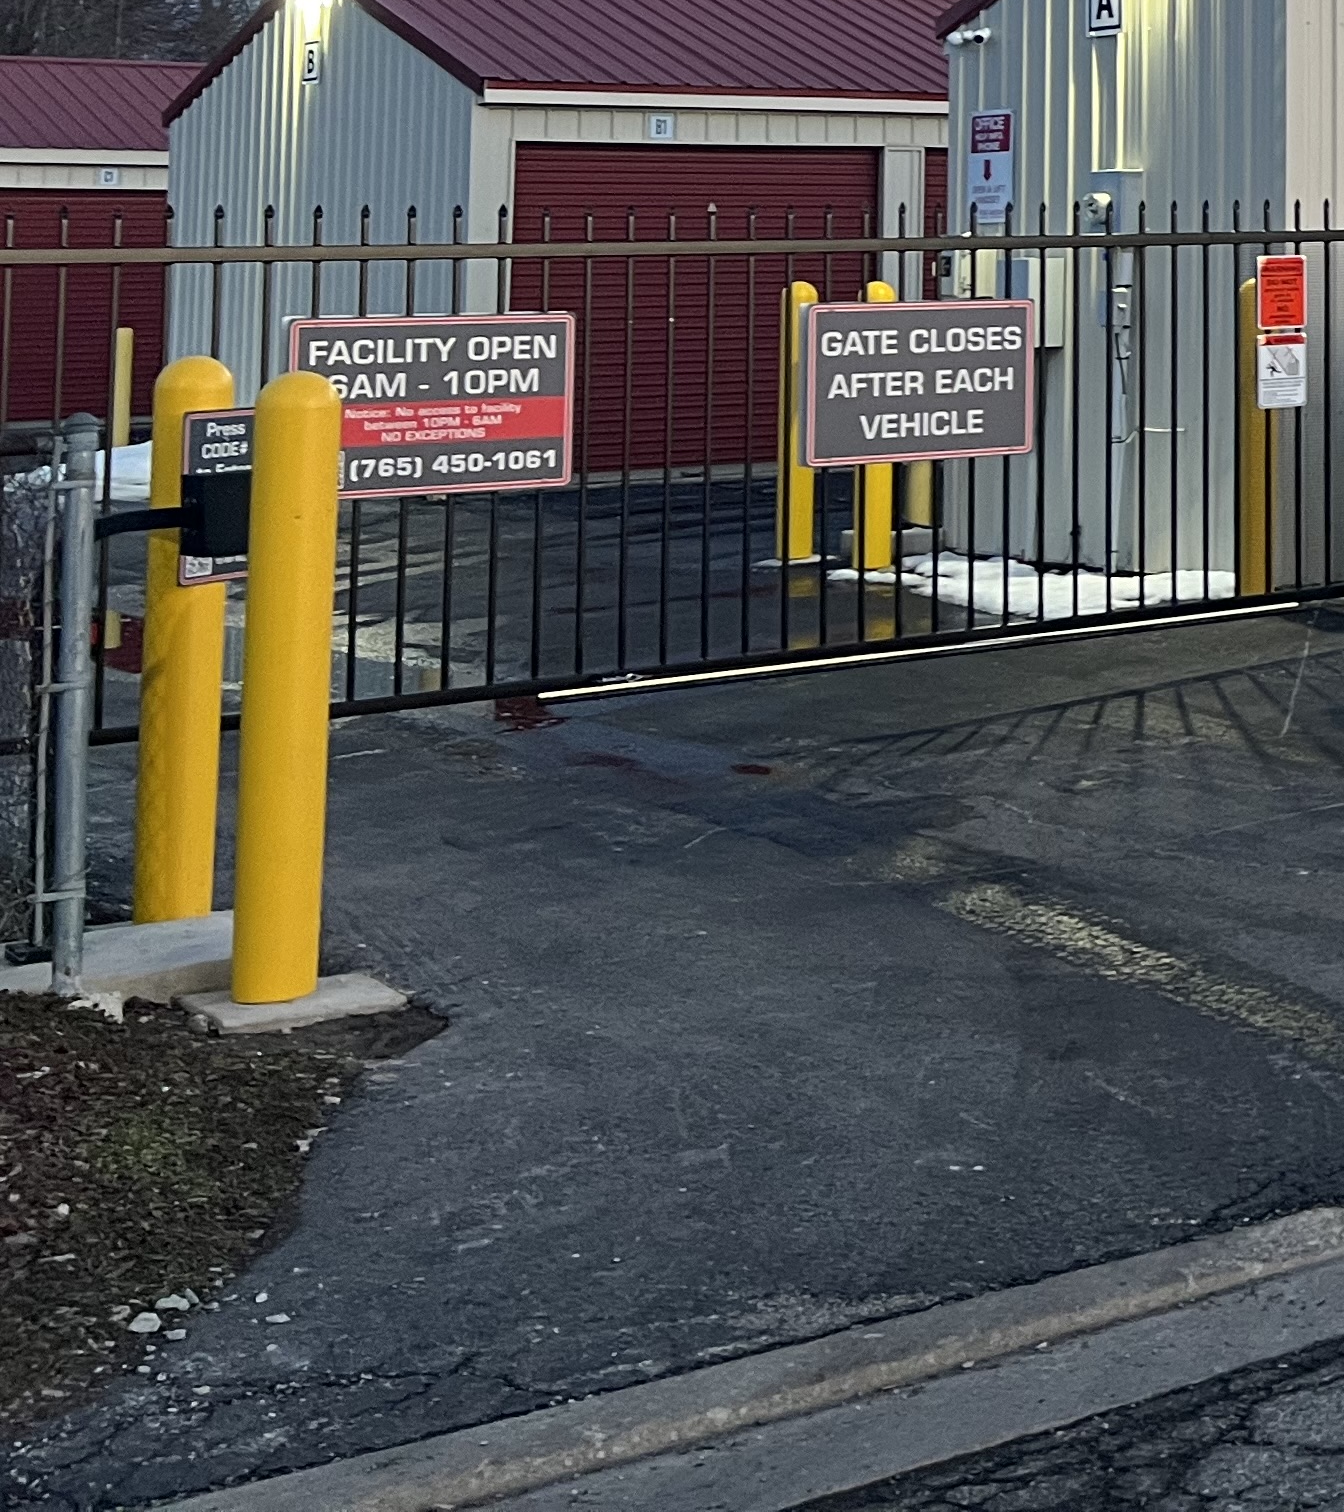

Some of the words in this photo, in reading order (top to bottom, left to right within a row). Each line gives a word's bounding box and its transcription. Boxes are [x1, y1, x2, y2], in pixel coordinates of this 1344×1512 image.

[307, 49, 315, 74] B
[308, 337, 457, 366] FACILITY
[467, 334, 557, 361] OPEN
[821, 330, 898, 357] GATE
[909, 326, 1022, 354] CLOSES
[327, 372, 407, 400] 6AM
[443, 367, 540, 396] 10PM
[827, 370, 924, 400] AFTER
[935, 367, 1014, 395] EACH
[363, 418, 417, 430] between
[423, 416, 461, 428] 10PM
[472, 414, 502, 426] 6AM
[395, 406, 414, 418] No
[418, 405, 461, 416] access
[464, 403, 478, 414] to
[481, 402, 522, 414] facility
[206, 422, 247, 438] Press
[381, 431, 402, 443] NO
[405, 427, 486, 442] EXCEPTIONS
[859, 409, 984, 440] VEHICLE
[201, 440, 249, 459] CODE#
[350, 456, 423, 482] (765)
[431, 449, 557, 475] 450-1061
